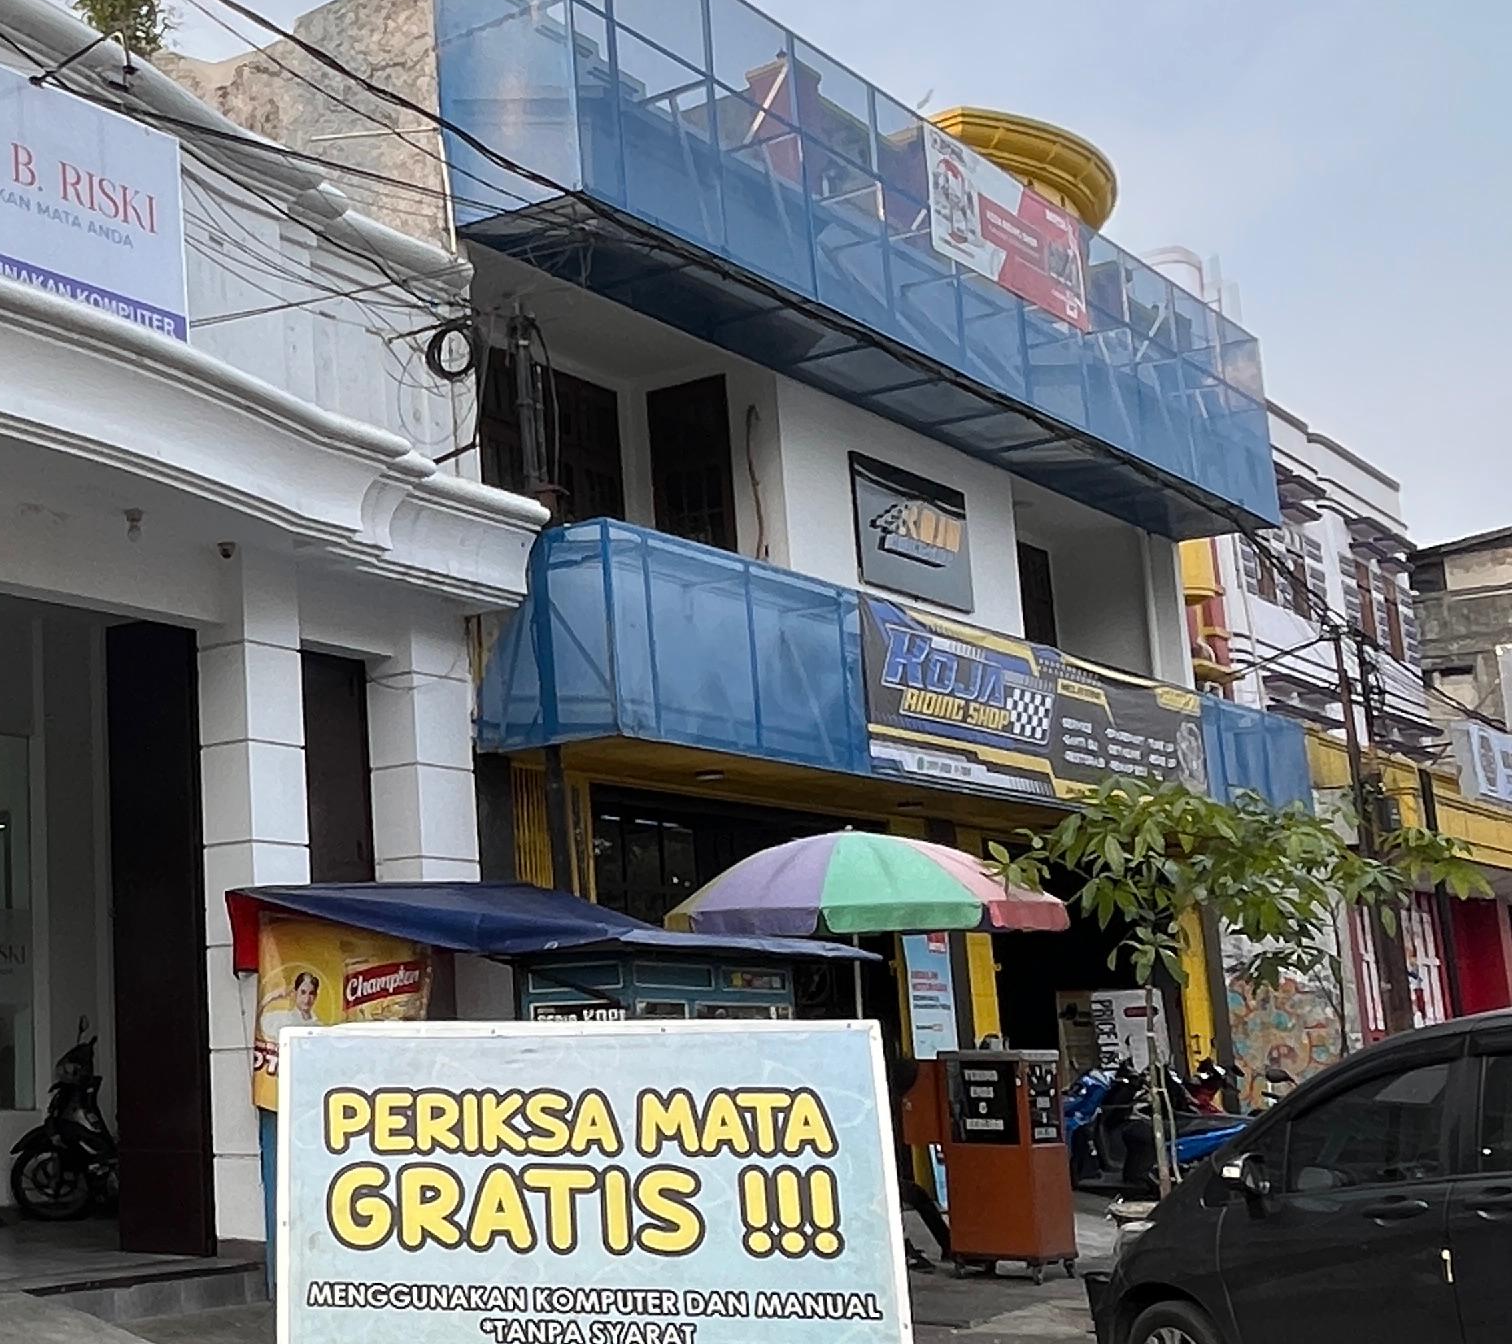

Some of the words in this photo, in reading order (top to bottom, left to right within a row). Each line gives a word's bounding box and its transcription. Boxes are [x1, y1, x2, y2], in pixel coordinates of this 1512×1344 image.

[11, 142, 44, 192] B.
[59, 160, 160, 235] RISKI
[37, 201, 82, 228] MATA
[87, 219, 134, 249] ANDA
[966, 702, 1011, 730] SHOP
[346, 965, 420, 1002] Champion
[322, 1087, 624, 1156] PERIKSA
[637, 1087, 840, 1158] MATA
[326, 1162, 706, 1256] GRATIS
[738, 1165, 847, 1259] !!!
[307, 1281, 526, 1312] MENGGUNAKAN
[533, 1286, 679, 1316] KOMPUTER
[685, 1290, 750, 1317] DAN
[755, 1292, 883, 1321] MANUAL
